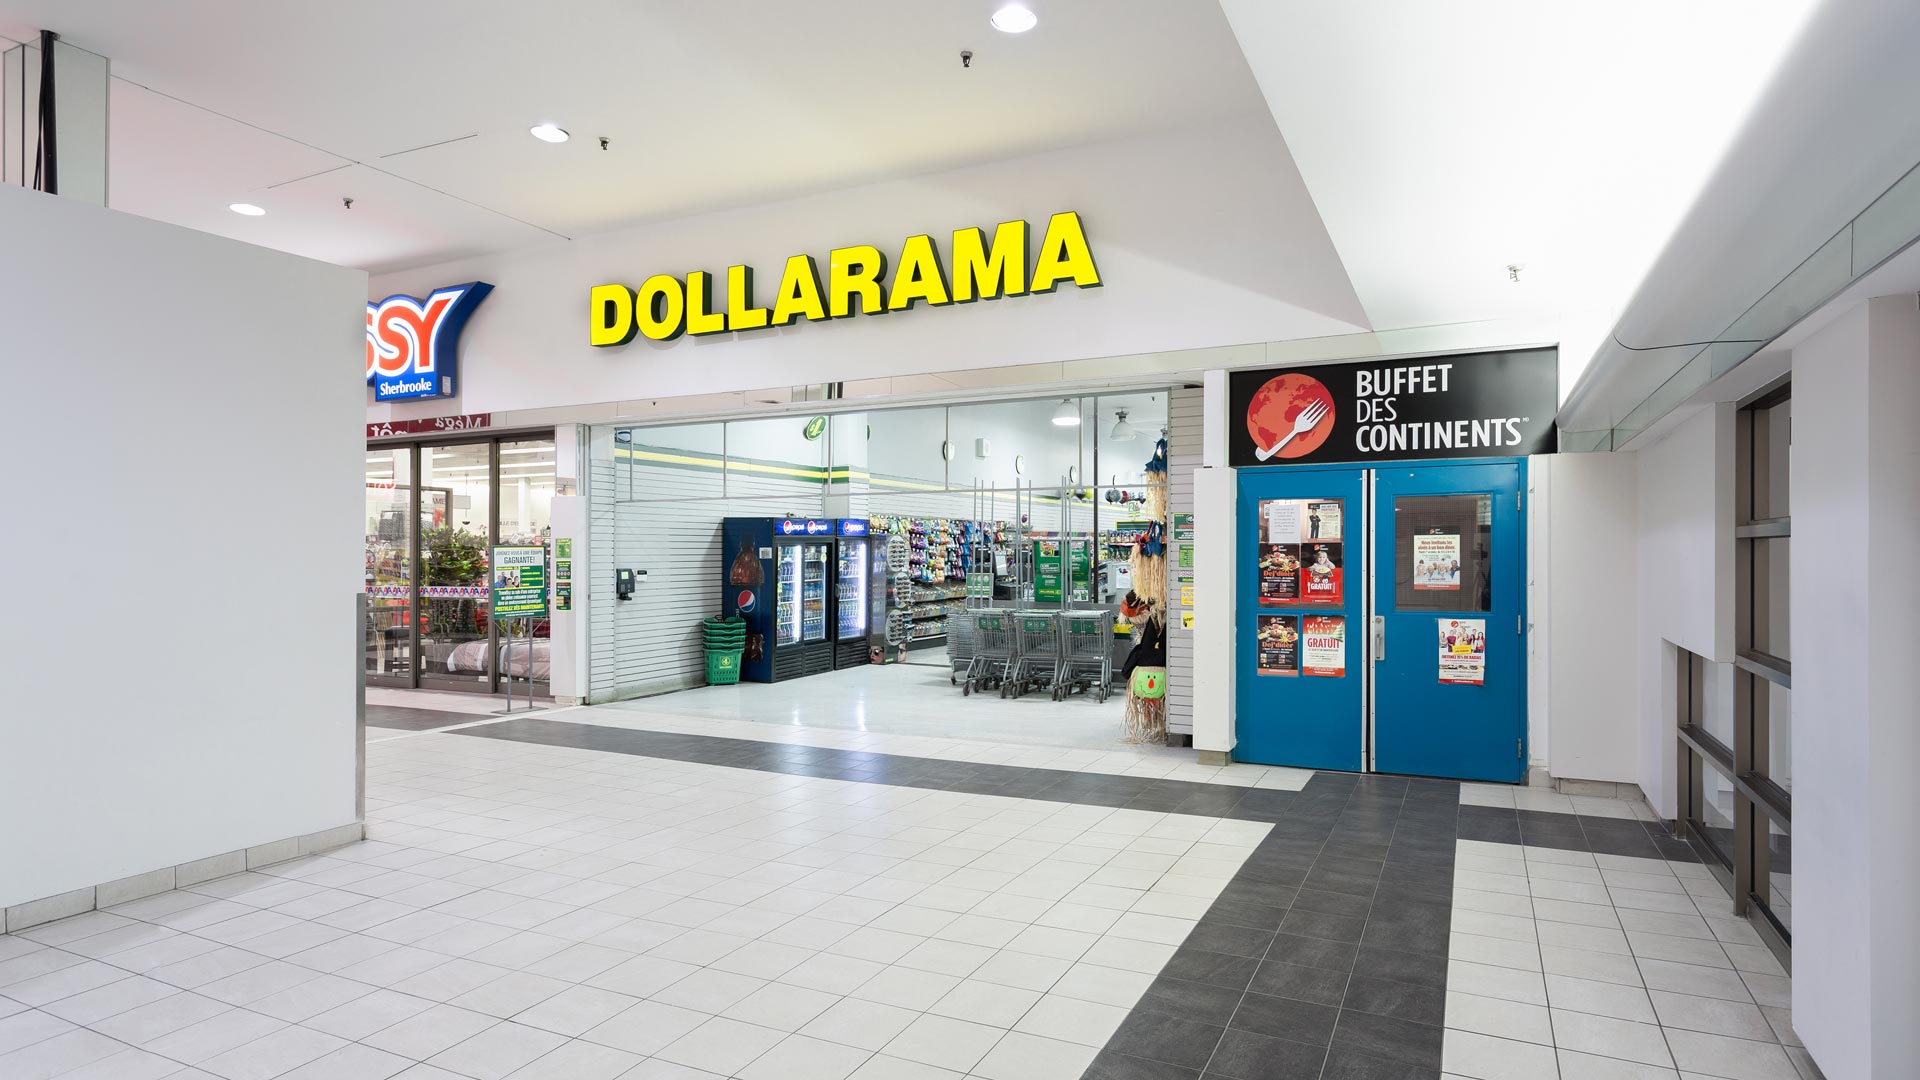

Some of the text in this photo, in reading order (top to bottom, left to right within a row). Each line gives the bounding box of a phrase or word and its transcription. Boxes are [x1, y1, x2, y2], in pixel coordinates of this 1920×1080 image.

[590, 211, 1102, 347] DOLLARAMA
[380, 378, 432, 396] Sherbrooke
[1356, 364, 1452, 397] BUFFET
[1356, 398, 1397, 423] DES
[1356, 417, 1522, 452] CONTINENTS
[504, 556, 535, 564] GAGNANTE!
[1310, 582, 1332, 590] GRATUIT
[1307, 638, 1339, 648] GRATUIT
